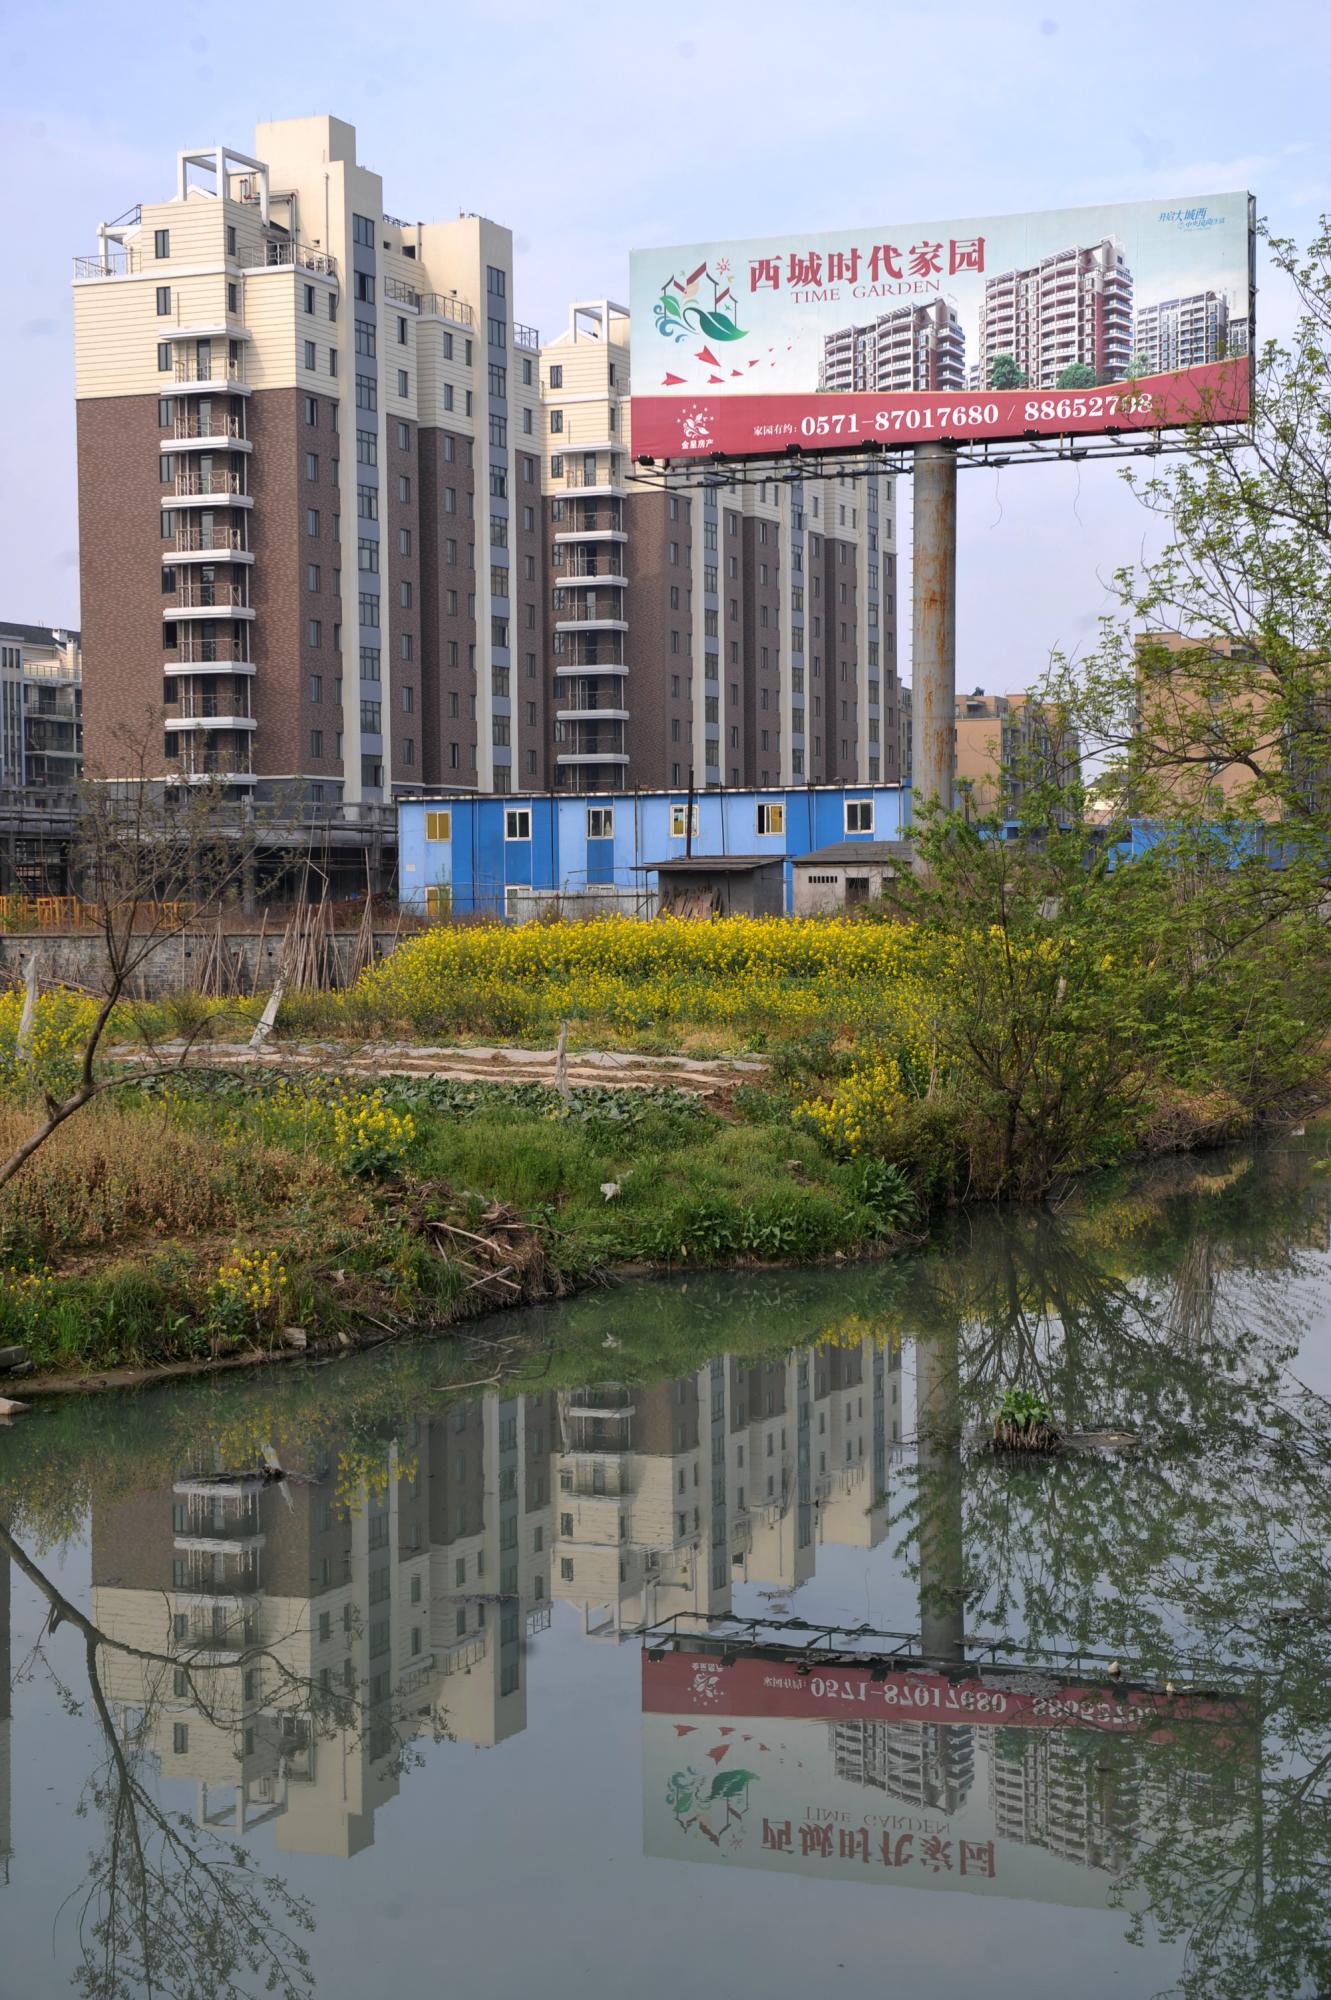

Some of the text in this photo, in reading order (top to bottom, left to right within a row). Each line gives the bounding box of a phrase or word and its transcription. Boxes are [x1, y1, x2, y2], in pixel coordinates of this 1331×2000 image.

[749, 236, 986, 292] 西城时代家园
[790, 279, 940, 304] TIME GARDEN
[800, 403, 999, 436] 0571-87017680
[681, 438, 714, 449] 金星房产
